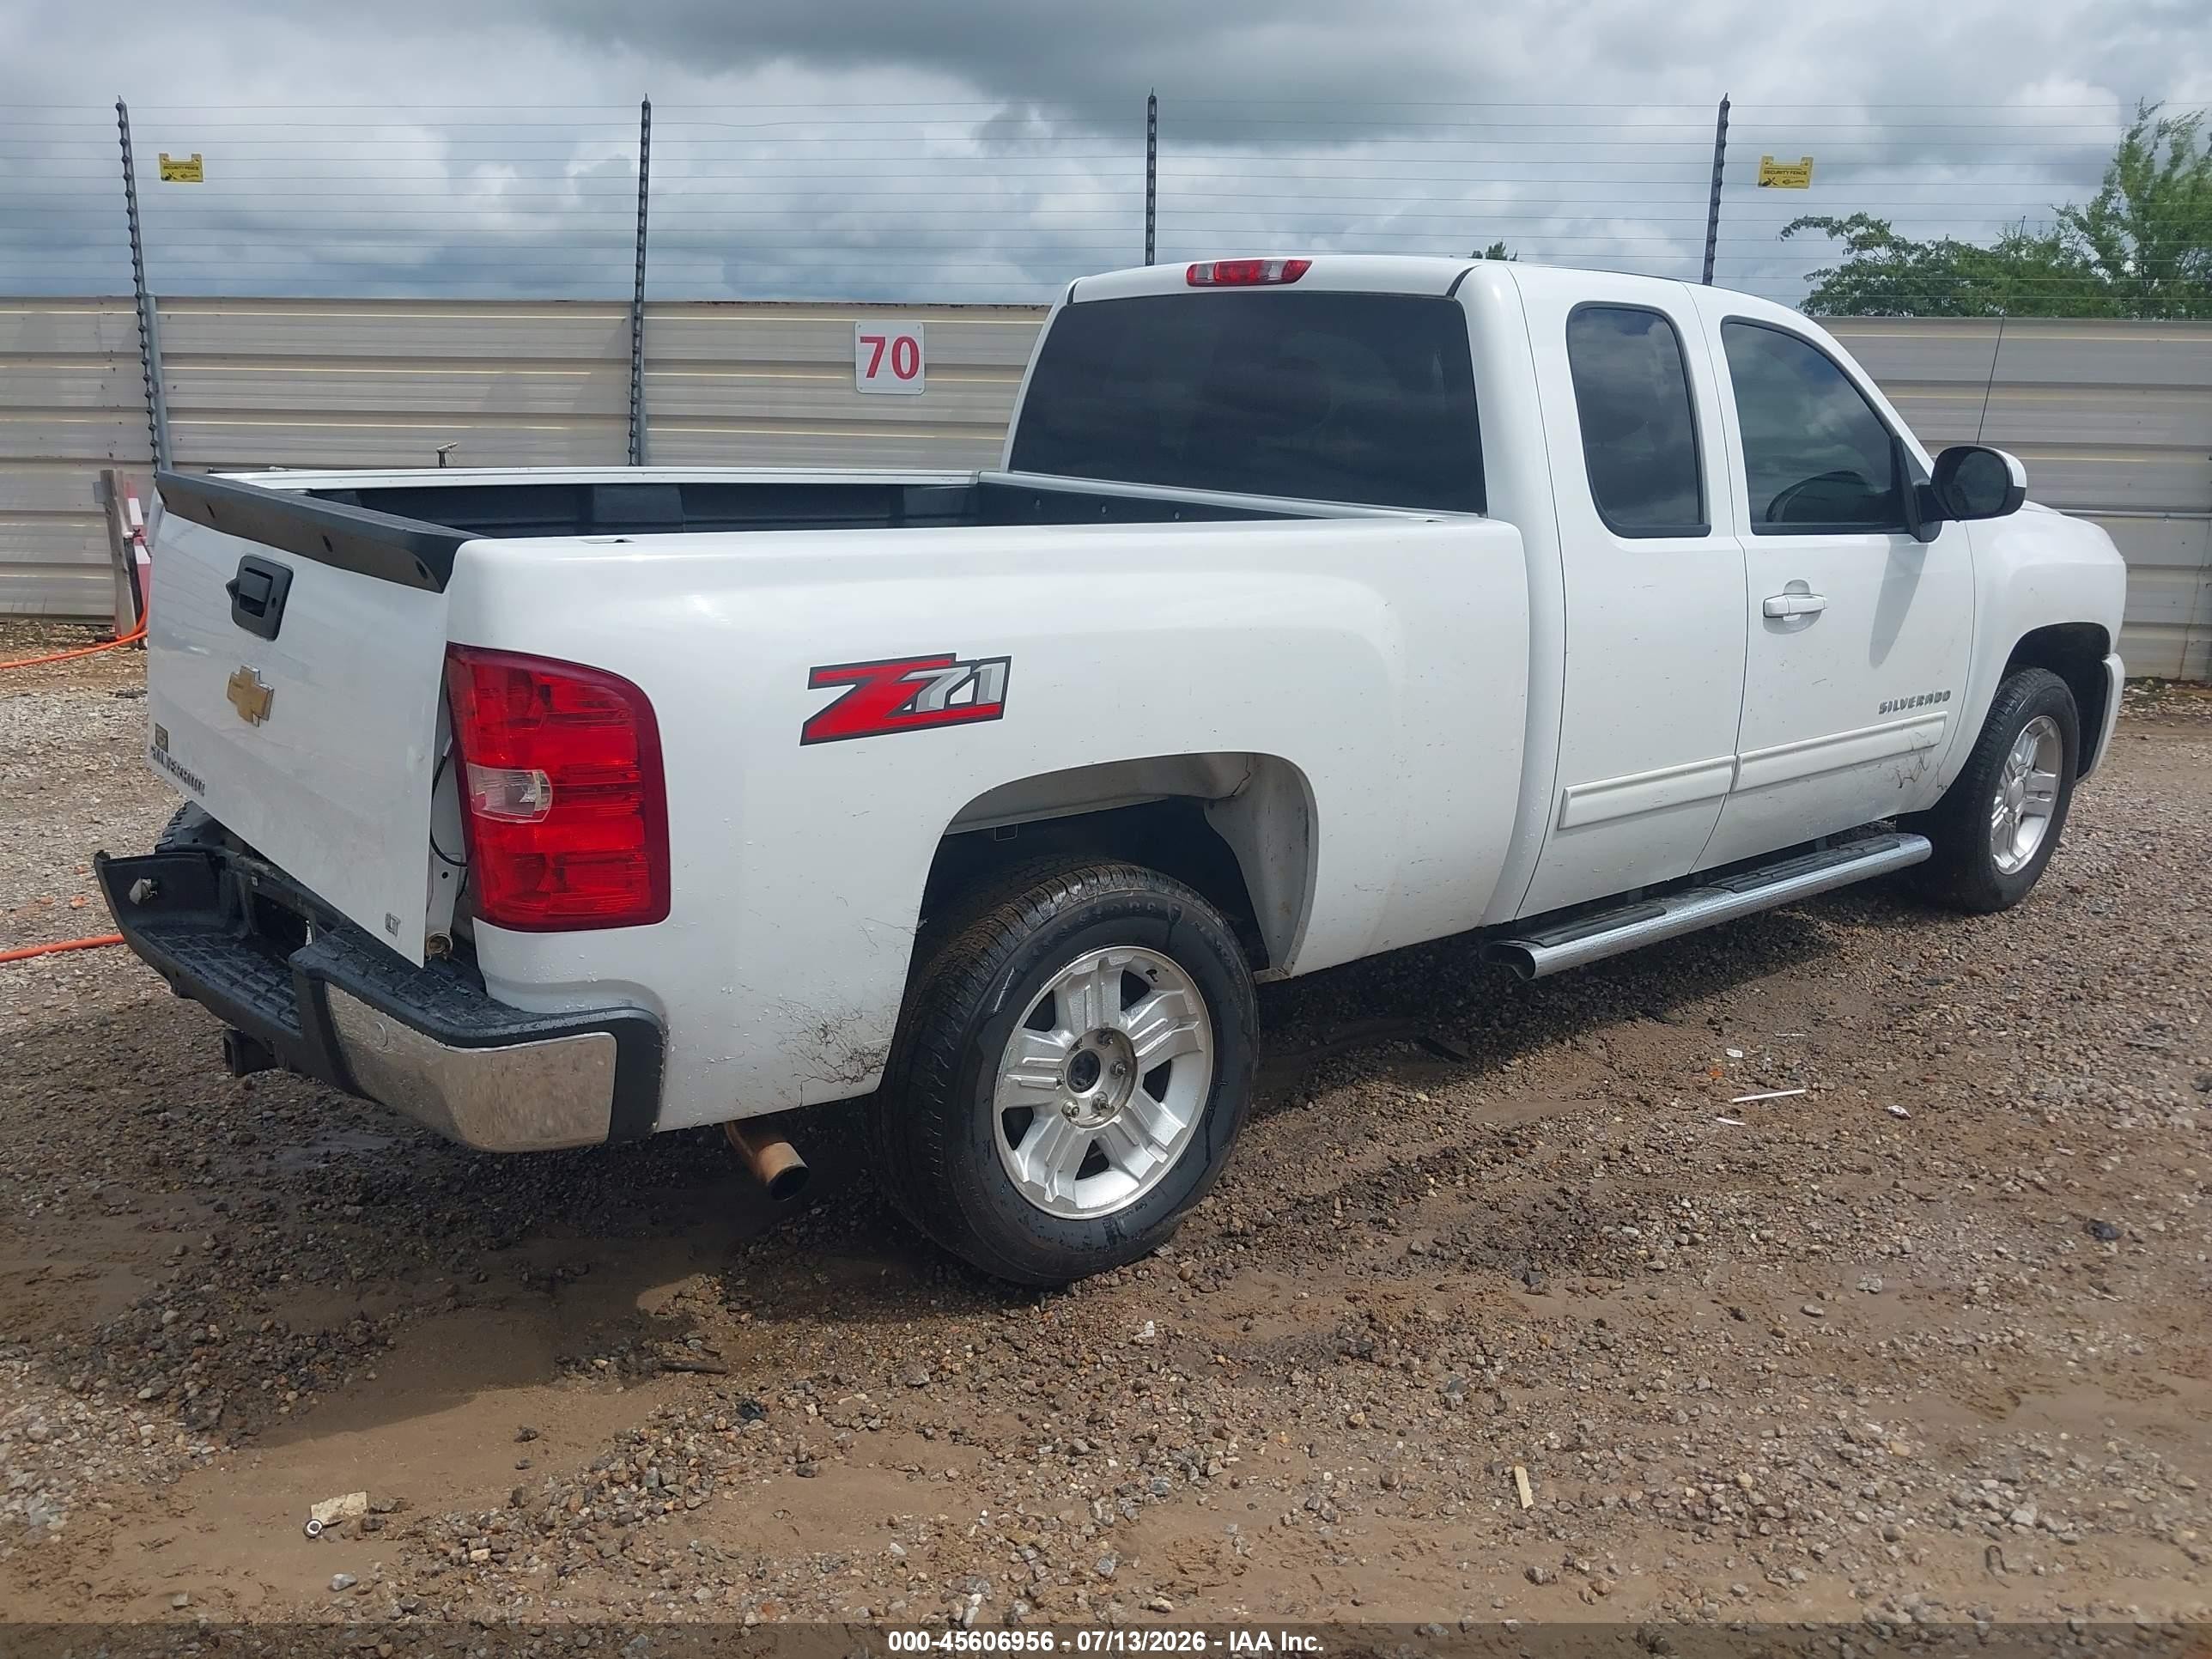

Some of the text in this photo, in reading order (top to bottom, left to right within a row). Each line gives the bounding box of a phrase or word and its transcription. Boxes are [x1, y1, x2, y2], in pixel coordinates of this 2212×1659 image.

[860, 336, 920, 380] 70
[799, 653, 1012, 746] Z71
[1878, 690, 1951, 714] SILVERADO
[385, 912, 401, 937] LT
